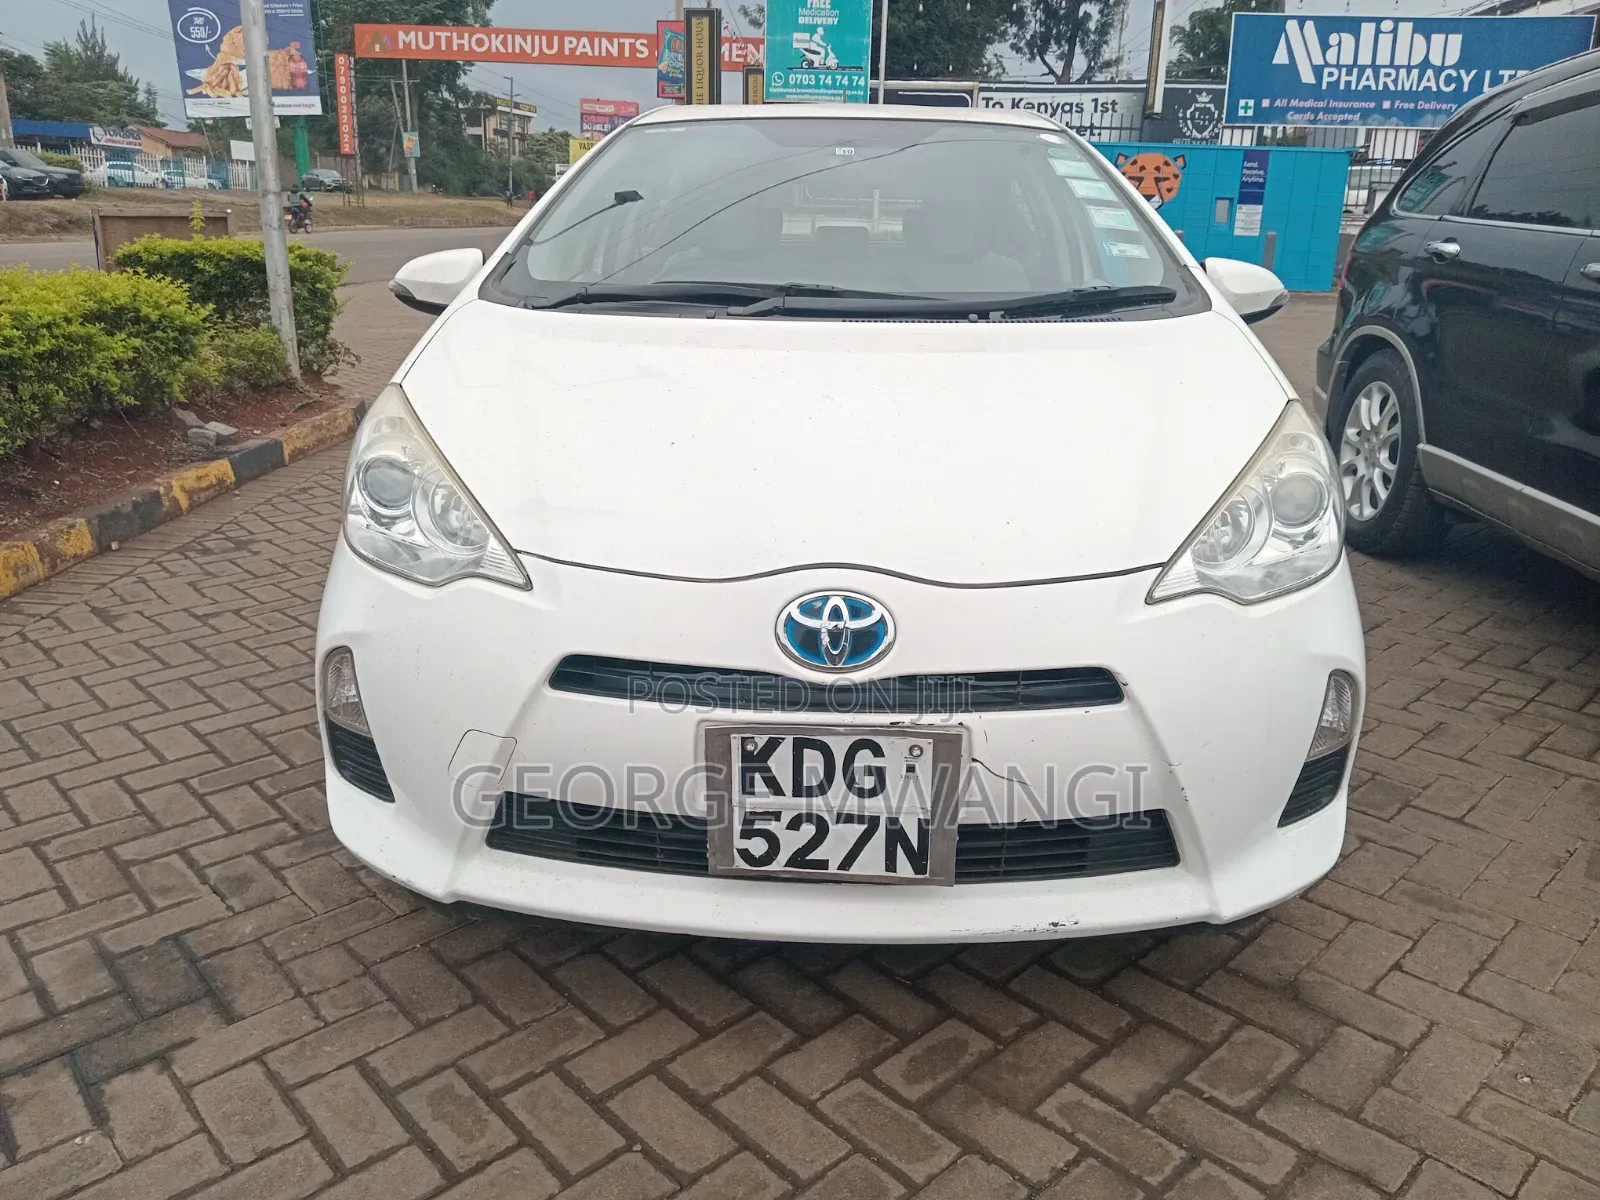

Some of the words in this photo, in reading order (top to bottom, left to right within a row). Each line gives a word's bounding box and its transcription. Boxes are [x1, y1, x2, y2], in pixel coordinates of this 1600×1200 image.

[798, 7, 840, 17] Medication
[798, 16, 839, 25] DELIVERY
[696, 16, 704, 49] HOUSE
[398, 30, 559, 58] MUTHOKINJU
[564, 35, 649, 59] PAINTS
[1271, 19, 1463, 84] Malibu
[696, 52, 705, 89] LIQUOR
[789, 73, 816, 85] 0703
[818, 74, 832, 86] 74
[835, 75, 849, 87] 74
[851, 75, 866, 87] 74
[1321, 67, 1478, 93] PHARMACY
[981, 97, 1004, 109] To
[1010, 97, 1084, 118] Kenyas
[1091, 97, 1118, 114] 1st
[1273, 98, 1287, 108] All
[1288, 98, 1328, 109] Medical
[1329, 99, 1376, 109] Insurance
[1394, 100, 1415, 110] Free
[1417, 100, 1458, 112] Delivery
[1287, 111, 1315, 121] Cards
[1316, 111, 1360, 123] Accepted
[740, 736, 887, 799] KDG
[735, 810, 931, 876] 527N
